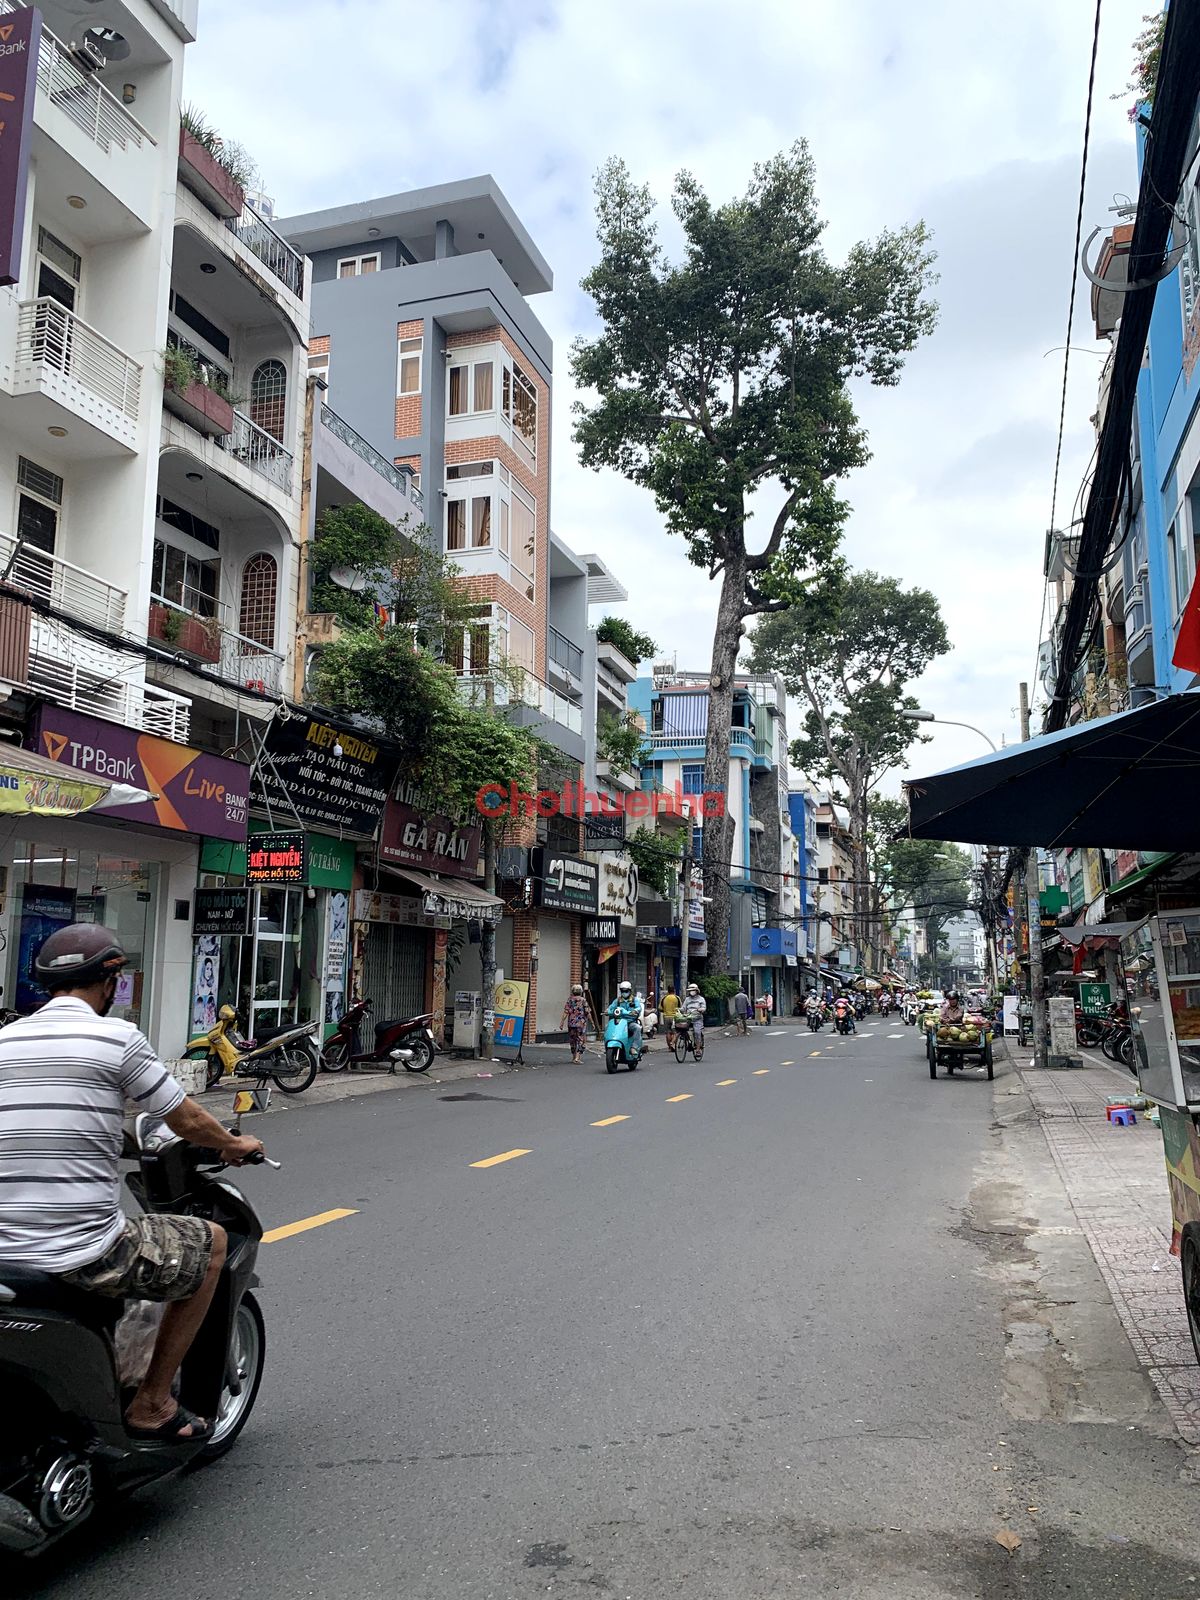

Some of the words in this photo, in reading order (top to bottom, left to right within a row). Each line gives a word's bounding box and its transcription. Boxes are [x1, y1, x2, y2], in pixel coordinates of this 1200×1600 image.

[69, 741, 136, 781] TPBank
[349, 763, 366, 778] TÓC
[184, 768, 225, 803] Live
[354, 784, 373, 798] TRANG
[225, 793, 247, 808] BANK
[226, 808, 245, 821] 24/7
[403, 820, 428, 850] GÀ
[251, 849, 269, 869] KIỆT
[270, 846, 300, 867] NGUYỄN
[250, 870, 270, 879] PHỤC
[285, 868, 300, 878] TÓC
[231, 893, 246, 908] TÓC
[599, 921, 616, 938] KHOA
[1087, 994, 1105, 1004] NHÀ
